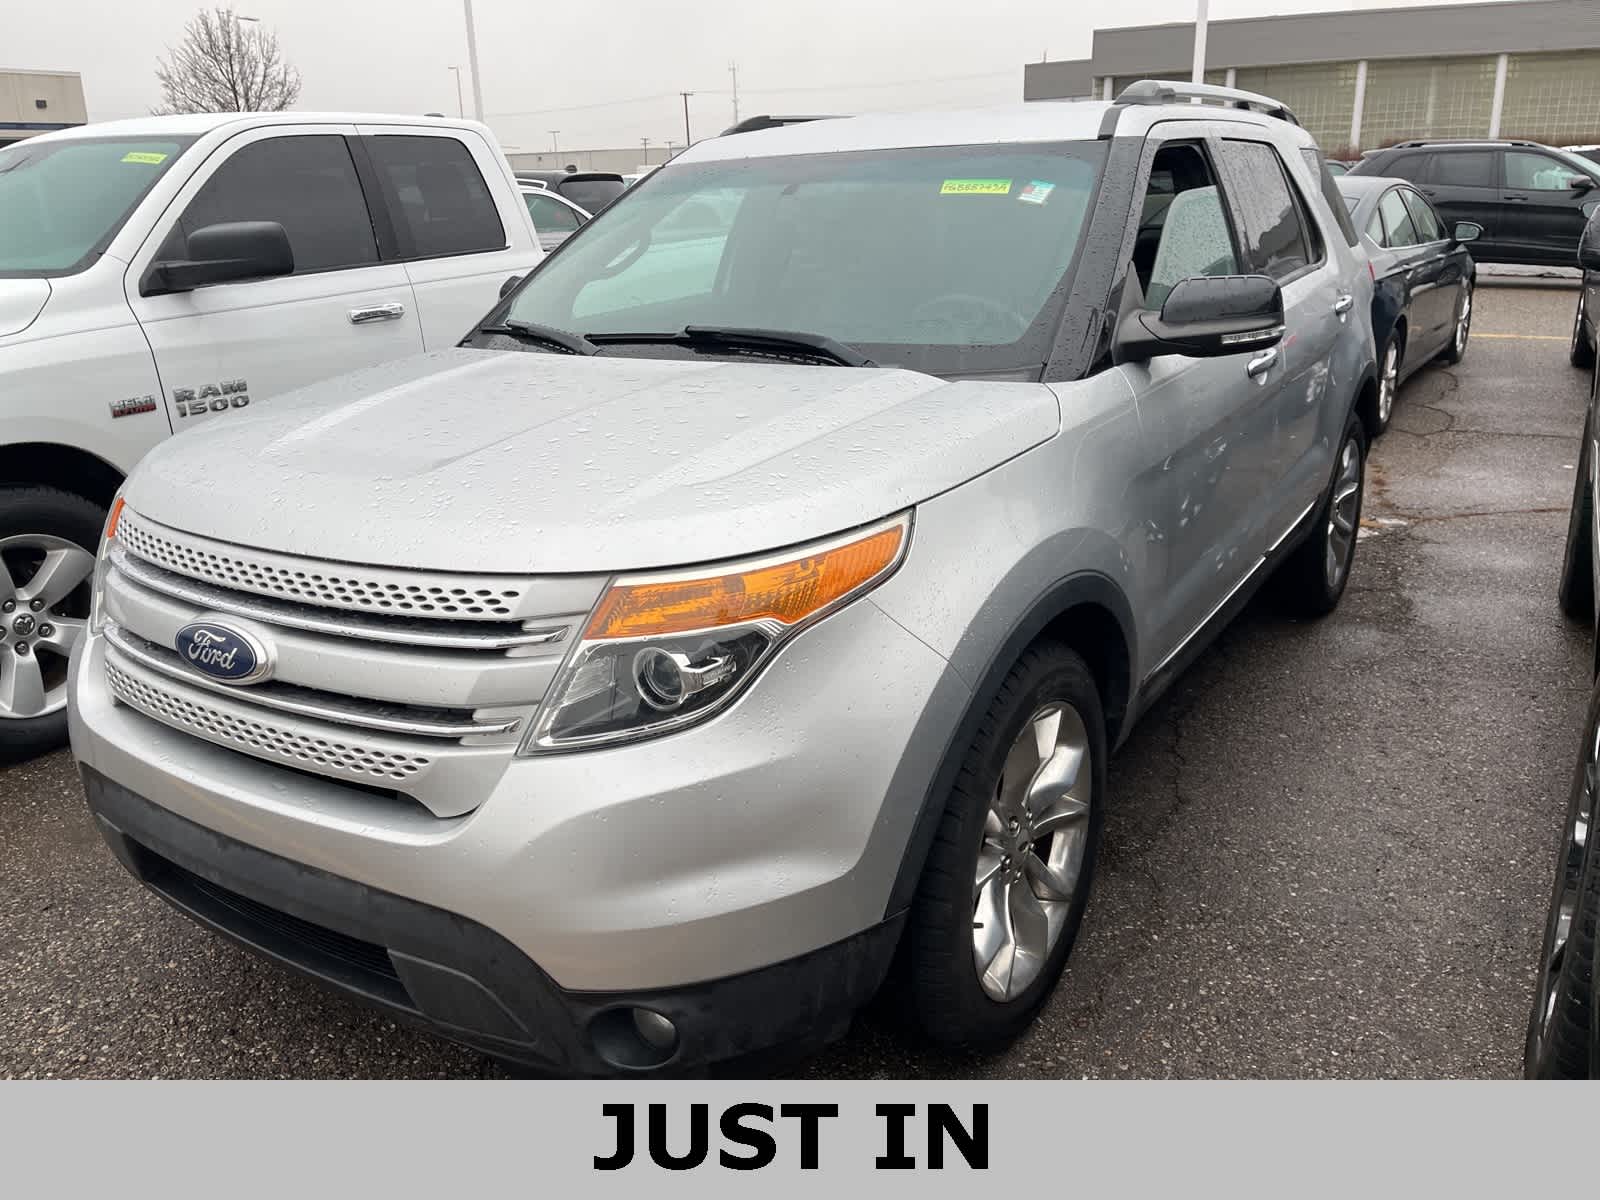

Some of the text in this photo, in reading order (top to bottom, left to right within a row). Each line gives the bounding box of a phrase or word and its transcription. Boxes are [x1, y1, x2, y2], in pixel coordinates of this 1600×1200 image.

[173, 380, 247, 403] RAM
[176, 395, 250, 418] 1500
[188, 629, 238, 670] Ford
